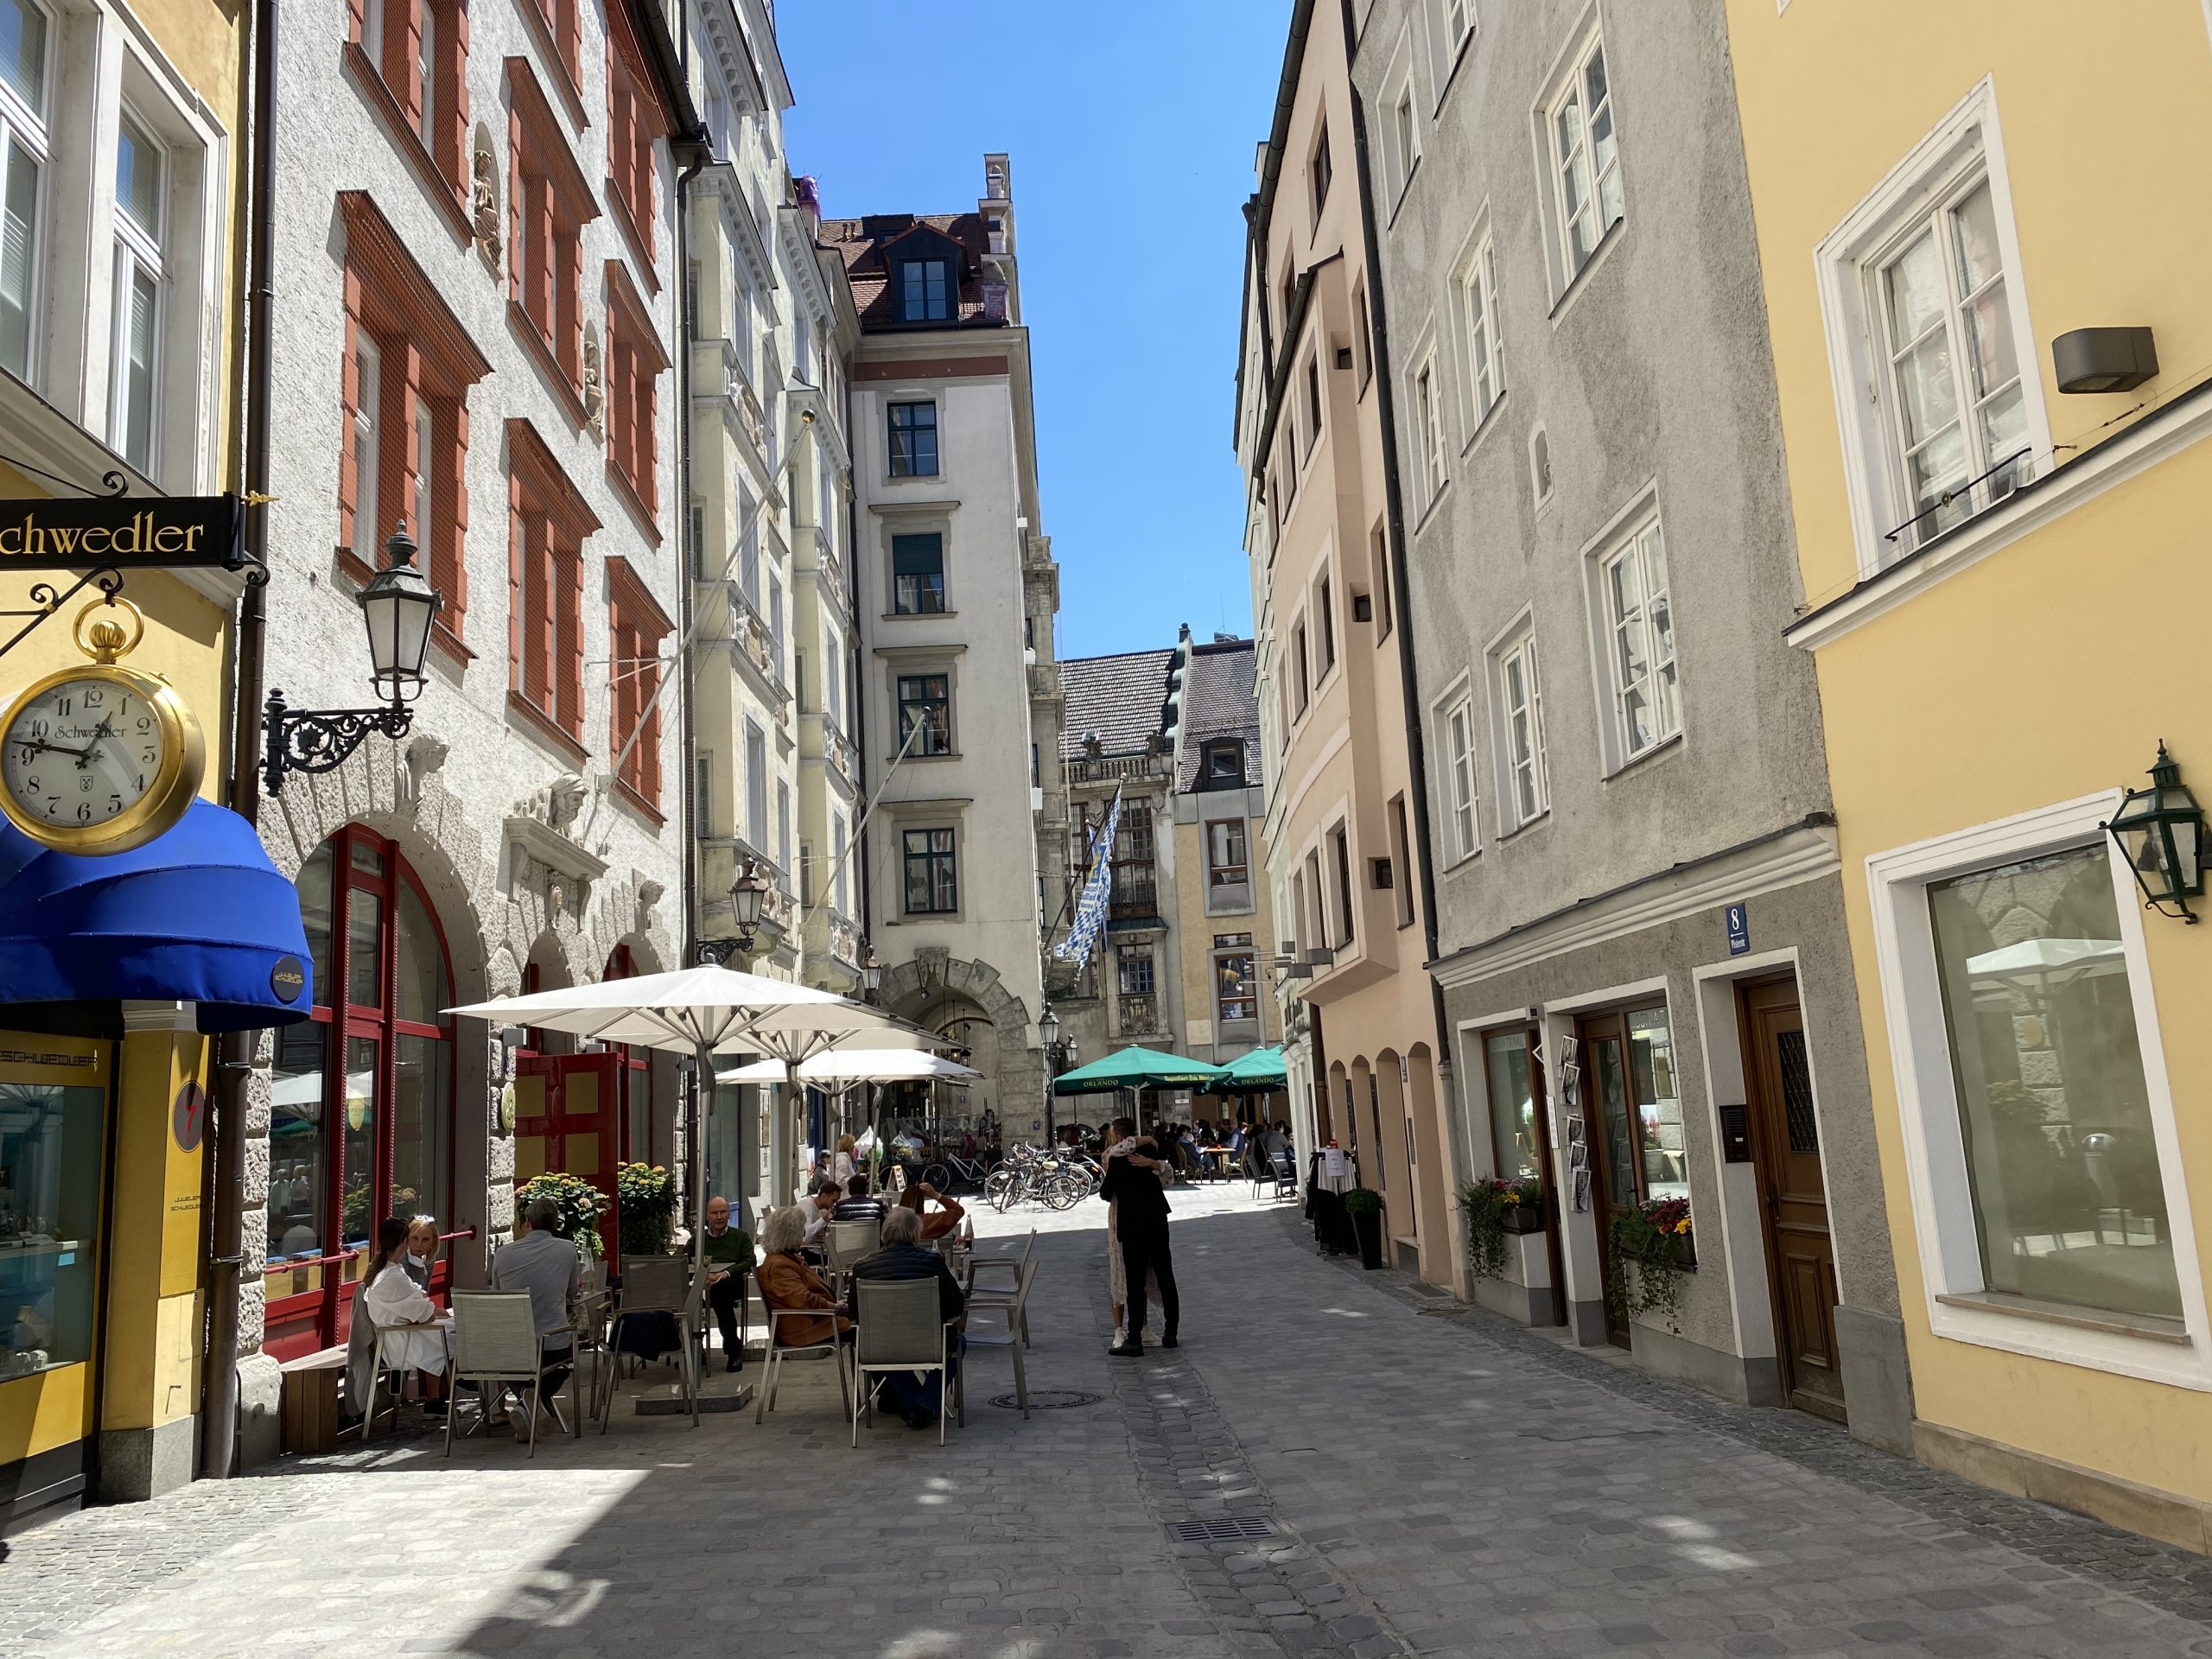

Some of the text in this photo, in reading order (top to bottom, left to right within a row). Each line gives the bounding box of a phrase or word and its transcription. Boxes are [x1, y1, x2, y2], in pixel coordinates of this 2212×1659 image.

[0, 512, 204, 554] chwedler
[56, 698, 71, 716] 11
[82, 690, 103, 709] 12
[118, 697, 127, 715] 1
[31, 719, 48, 737] 10
[137, 717, 150, 735] 2
[22, 747, 35, 766] 9
[143, 746, 156, 764] 3
[27, 776, 40, 794] 8
[130, 774, 147, 791] 4
[46, 796, 61, 814] 7
[77, 803, 90, 821] 6
[108, 794, 121, 813] 5
[1731, 908, 1739, 930] 8
[1, 1050, 98, 1066] SCHWEDLER
[1083, 1079, 1119, 1088] ORLANDO
[186, 1104, 196, 1131] 7
